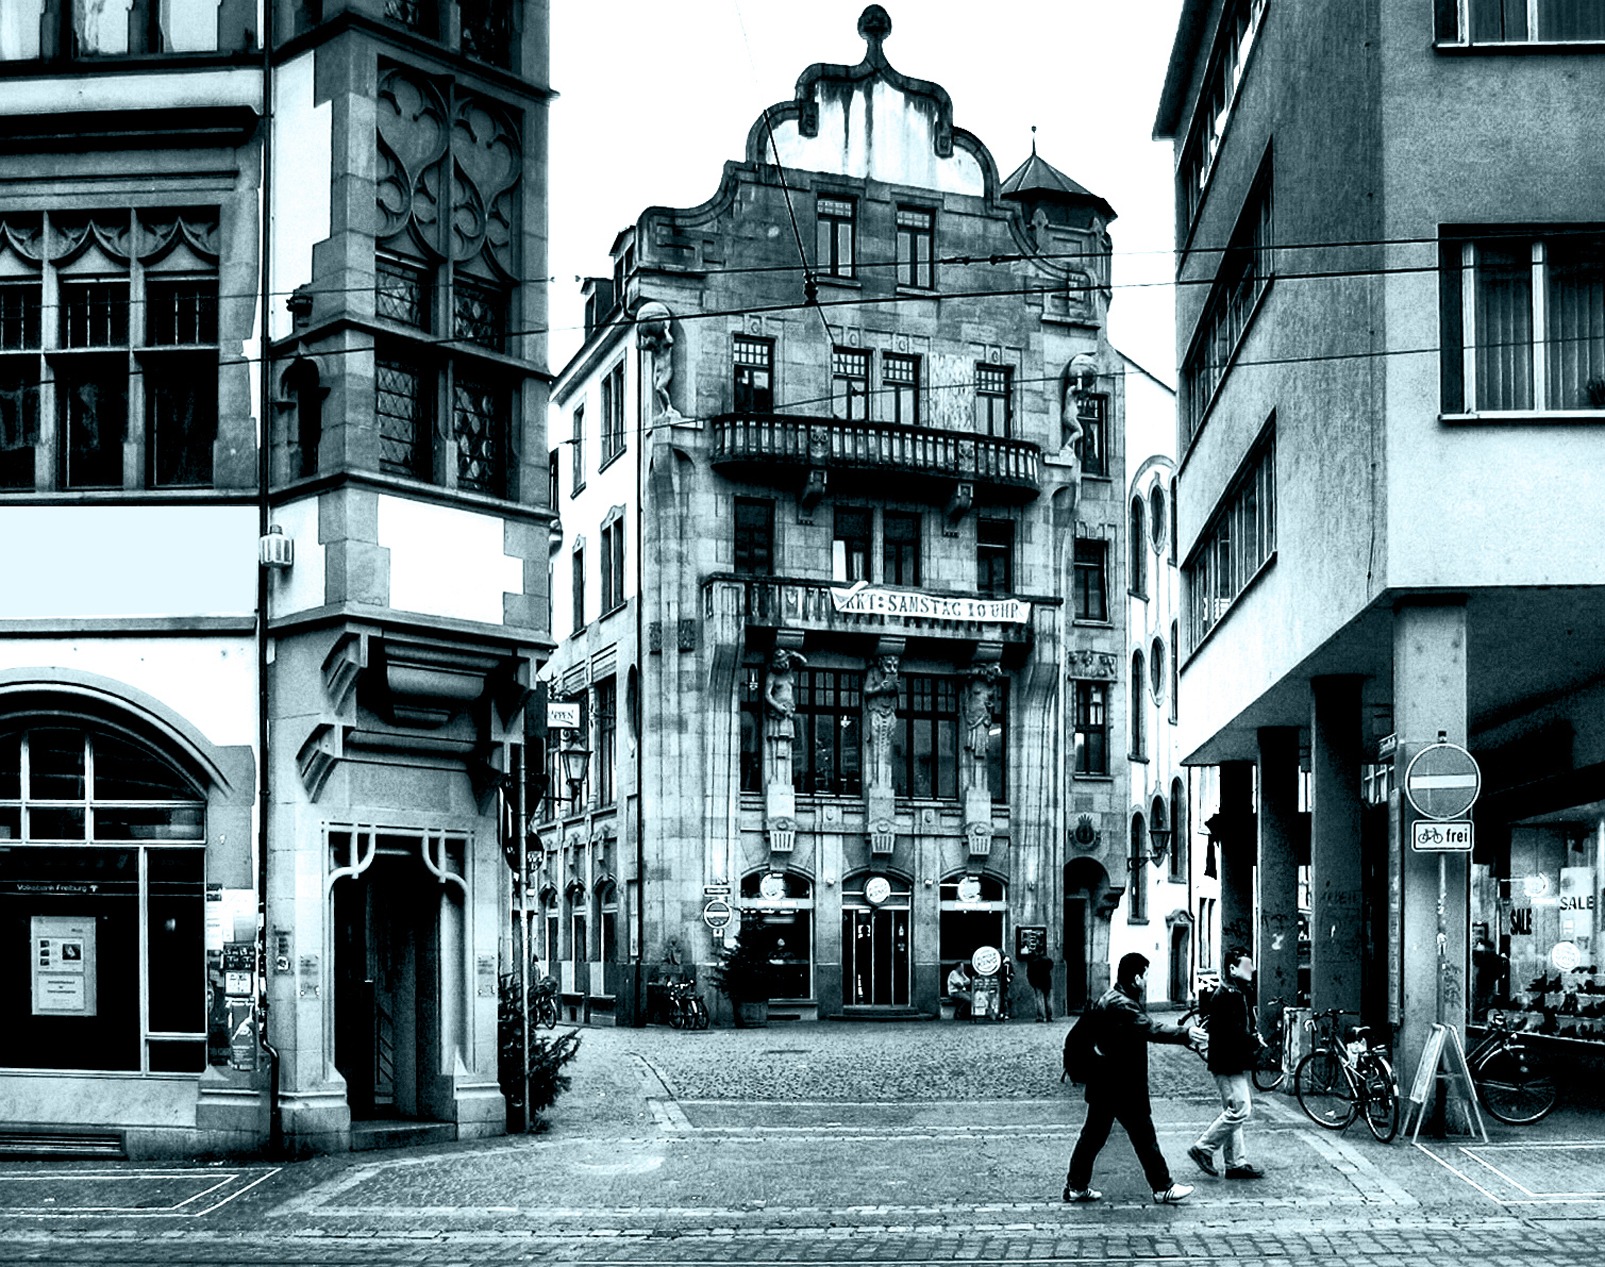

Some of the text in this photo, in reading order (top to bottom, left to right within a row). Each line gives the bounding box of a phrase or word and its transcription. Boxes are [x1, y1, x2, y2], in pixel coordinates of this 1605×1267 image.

[888, 594, 961, 616] SAMSTAG
[968, 603, 986, 617] 10
[990, 602, 1020, 619] UHR
[1446, 828, 1468, 843] frei
[1560, 895, 1595, 911] SALE
[1510, 908, 1533, 936] SALE
